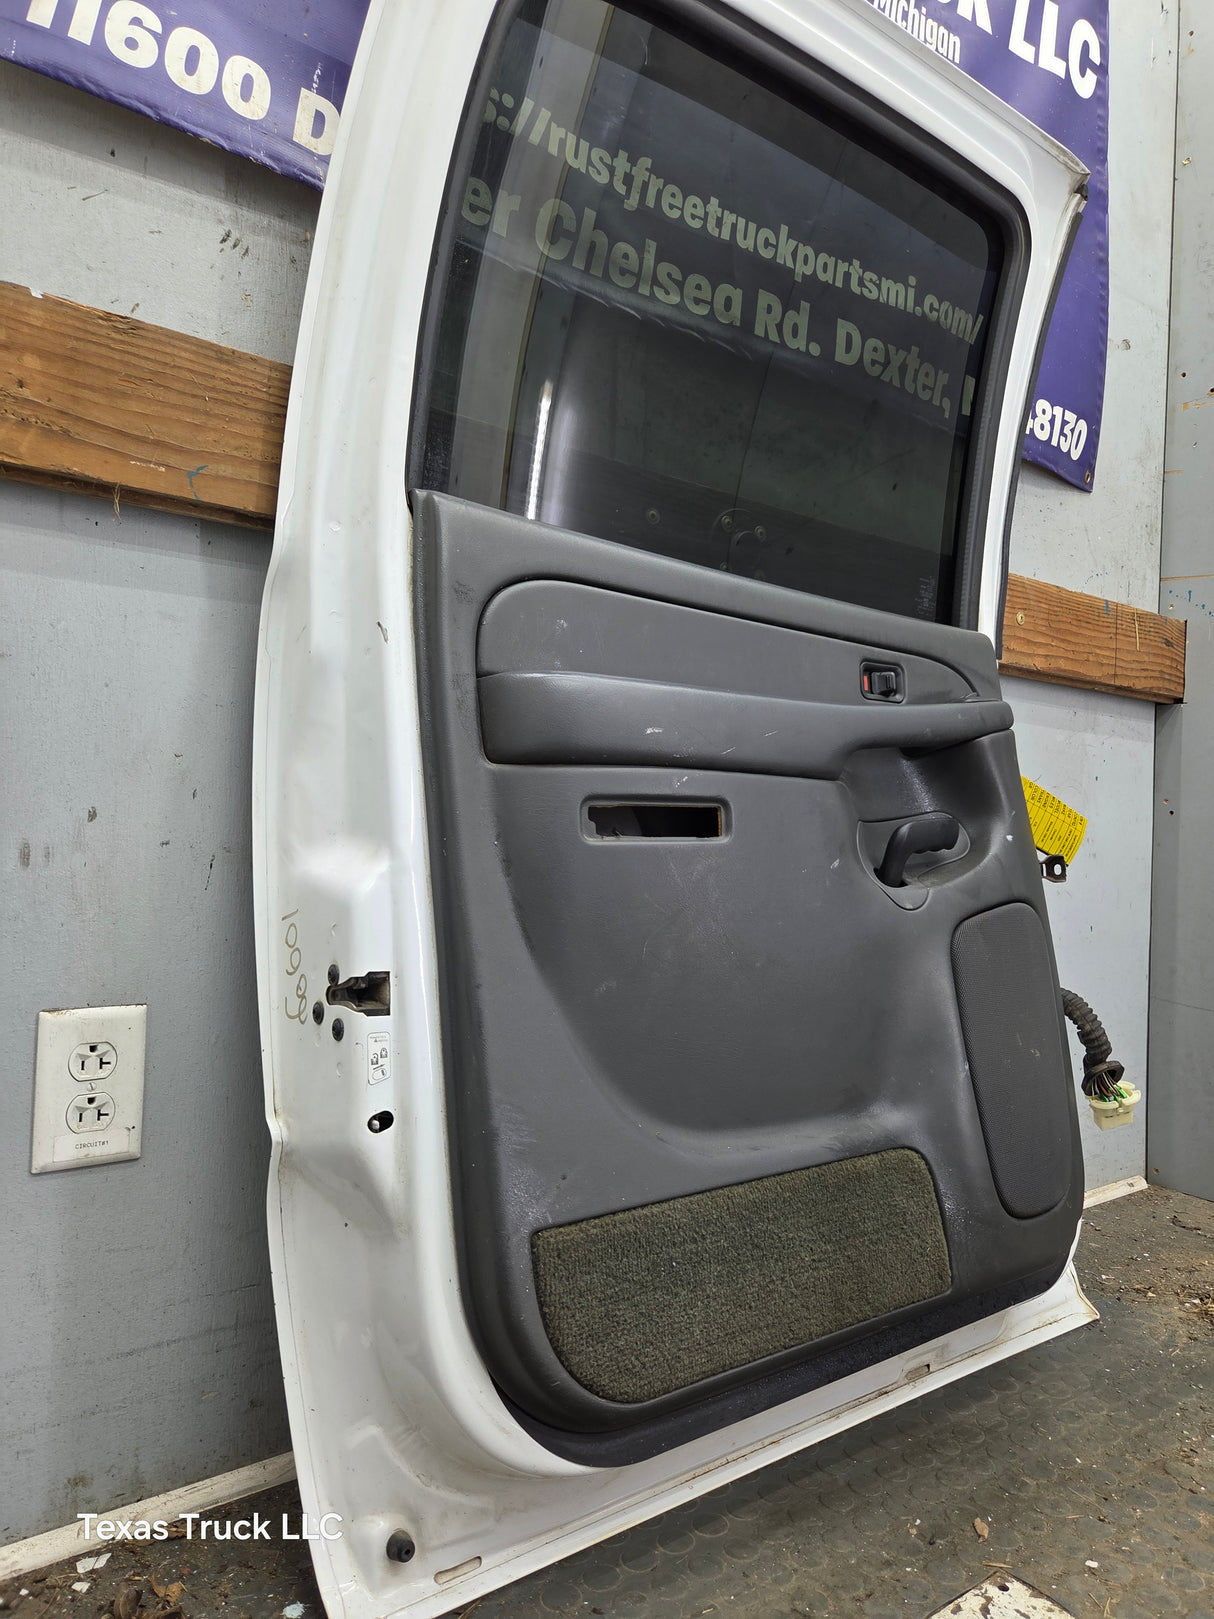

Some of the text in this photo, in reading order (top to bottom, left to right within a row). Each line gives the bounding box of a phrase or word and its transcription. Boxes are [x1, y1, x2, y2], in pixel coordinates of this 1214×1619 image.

[1008, 0, 1101, 99] LLC
[535, 197, 743, 327] Chelsea
[753, 288, 822, 357] Rd.
[834, 317, 949, 419] Dexter,
